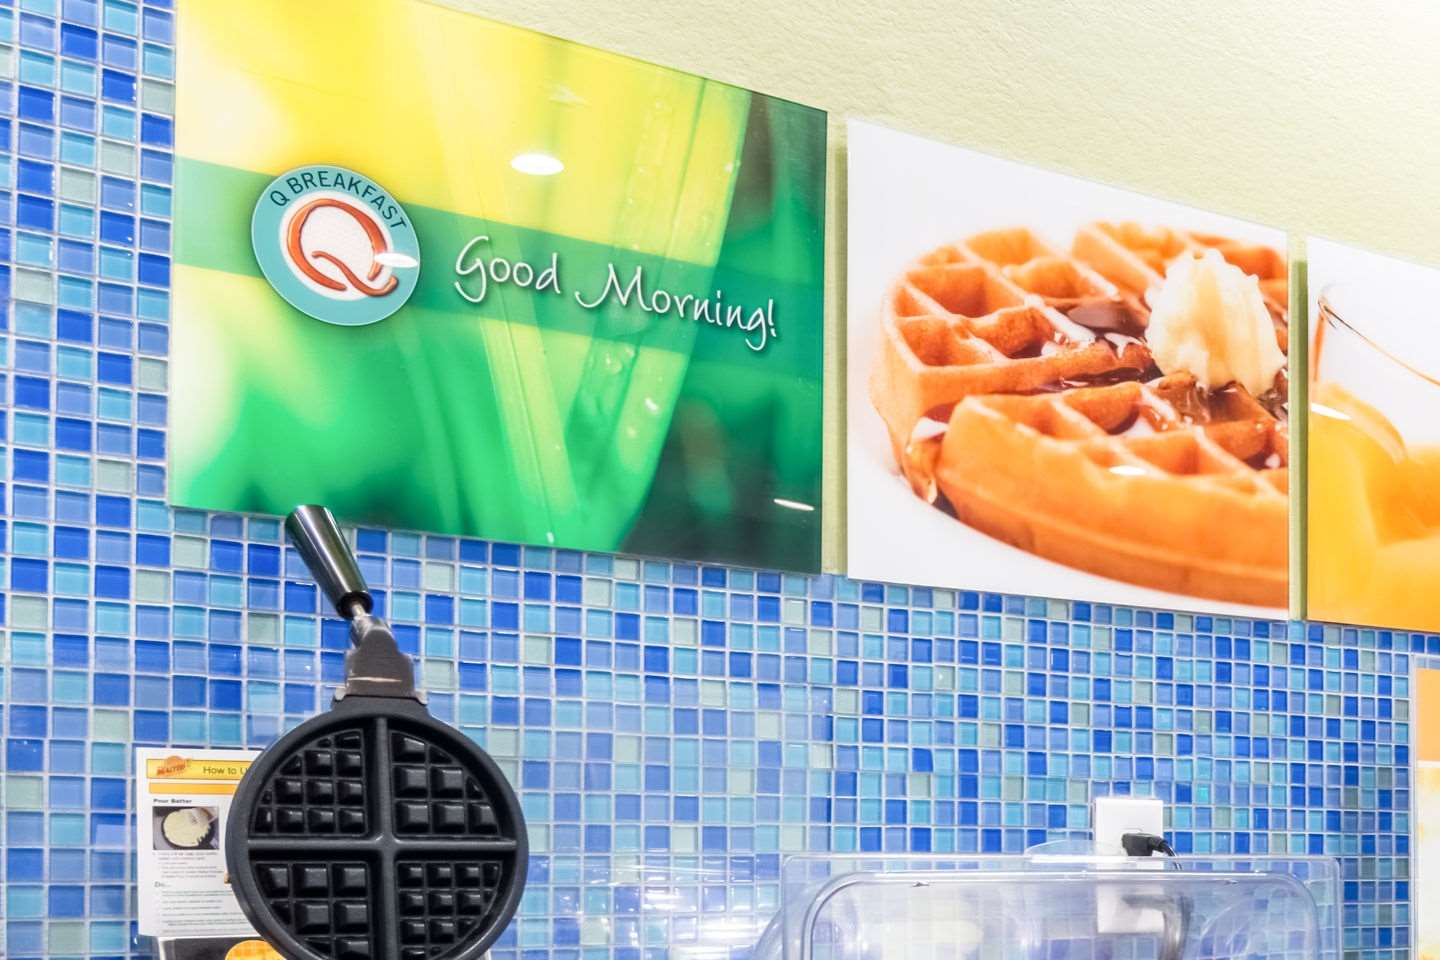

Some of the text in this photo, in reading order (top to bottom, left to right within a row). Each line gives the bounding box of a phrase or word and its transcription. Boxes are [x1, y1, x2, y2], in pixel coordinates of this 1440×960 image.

[269, 170, 407, 229] Q BREAKFAST
[454, 235, 777, 351] Good Morning!
[203, 766, 225, 775] How
[227, 766, 237, 775] to
